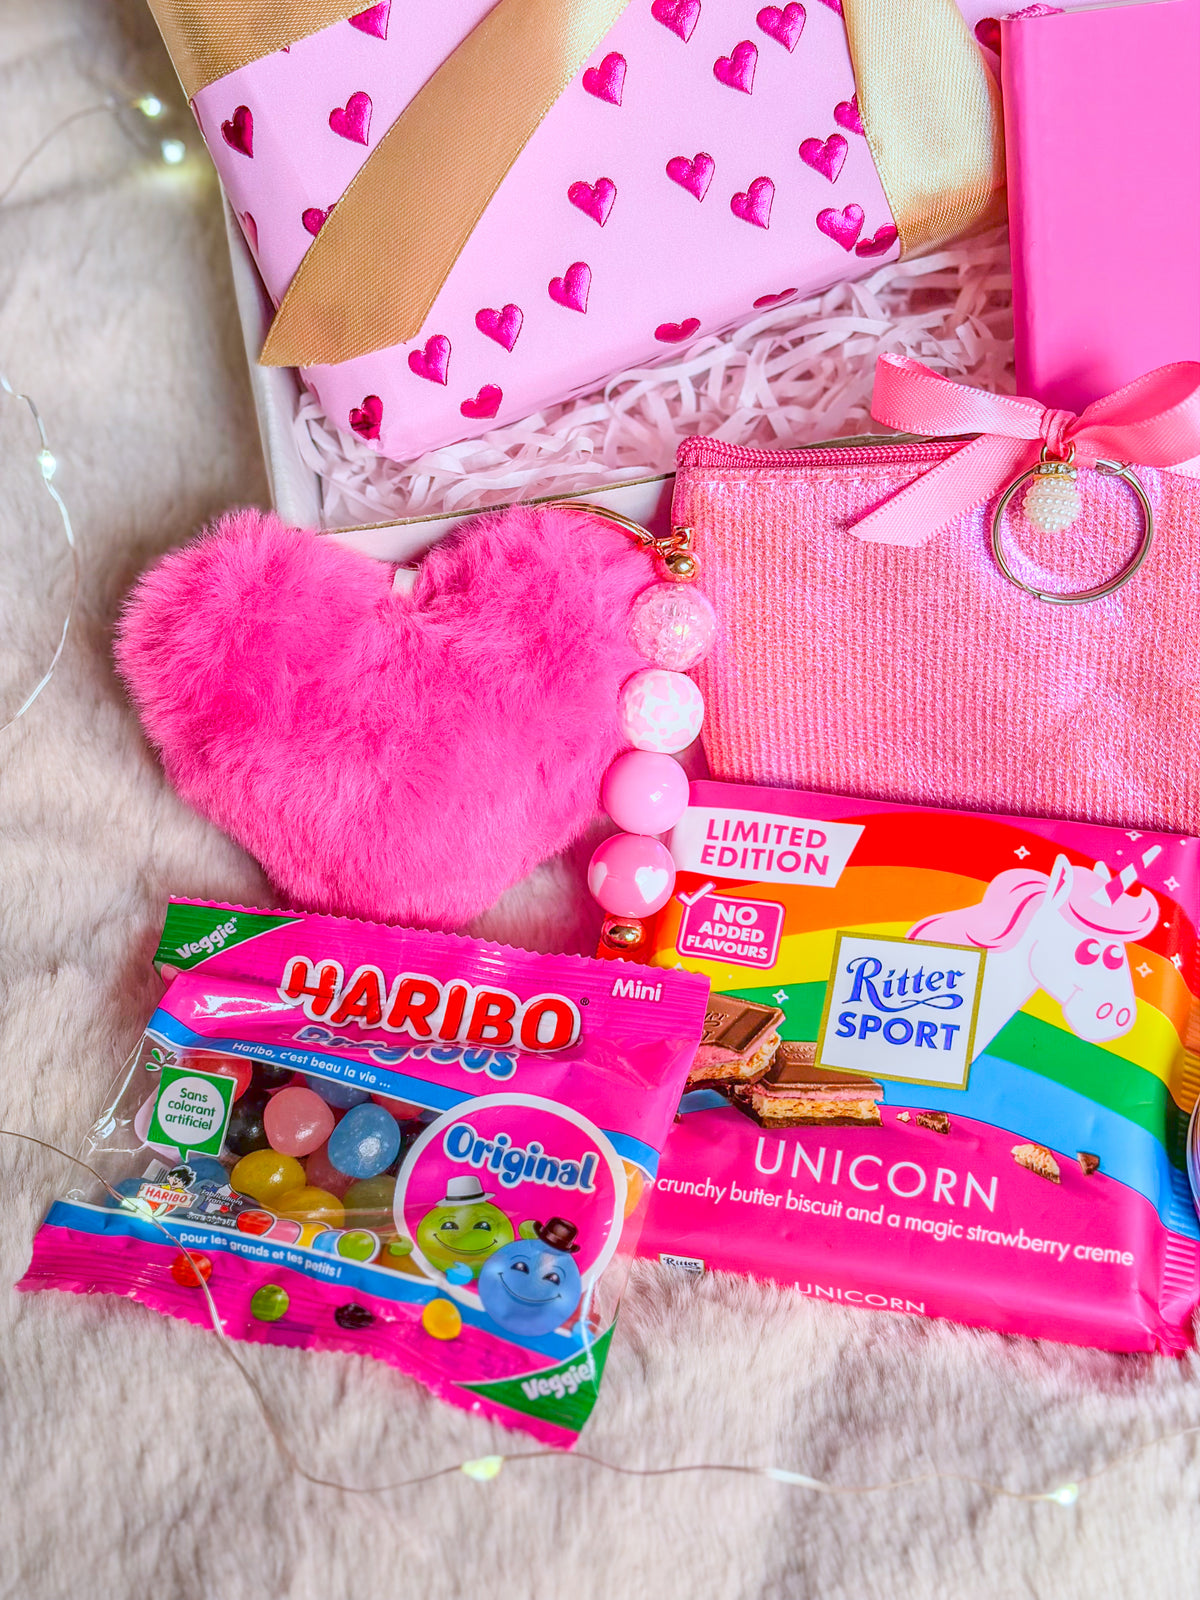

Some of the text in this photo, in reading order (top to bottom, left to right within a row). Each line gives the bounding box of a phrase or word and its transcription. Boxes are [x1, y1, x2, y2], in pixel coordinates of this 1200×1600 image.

[706, 818, 828, 849] LIMITED
[700, 844, 830, 876] EDITION
[713, 902, 758, 925] NO
[686, 935, 768, 960] FLAVOURS
[699, 921, 765, 943] ADDED
[611, 978, 663, 1002] Mini
[841, 956, 966, 1013] Ritter
[282, 958, 579, 1052] HARIBO
[835, 1011, 961, 1051] SPORT
[232, 1042, 276, 1059] Haribo,
[280, 1050, 309, 1066] c'est
[310, 1056, 341, 1076] beau
[344, 1066, 356, 1078] la
[358, 1070, 377, 1085] vie
[167, 1100, 216, 1117] colorant
[179, 1088, 209, 1103] Sans
[165, 1113, 213, 1130] artificiel
[444, 1124, 599, 1191] Original
[755, 1136, 998, 1213] UNICORN
[145, 1186, 188, 1204] HARIBO
[657, 1177, 1135, 1266] crunchy butter biscuit and a magic strawberry creme
[180, 1232, 208, 1243] pour
[211, 1235, 228, 1246] les
[230, 1241, 270, 1258] grands
[272, 1248, 285, 1260] et
[287, 1251, 303, 1264] les
[794, 1281, 925, 1313] UNICORN
